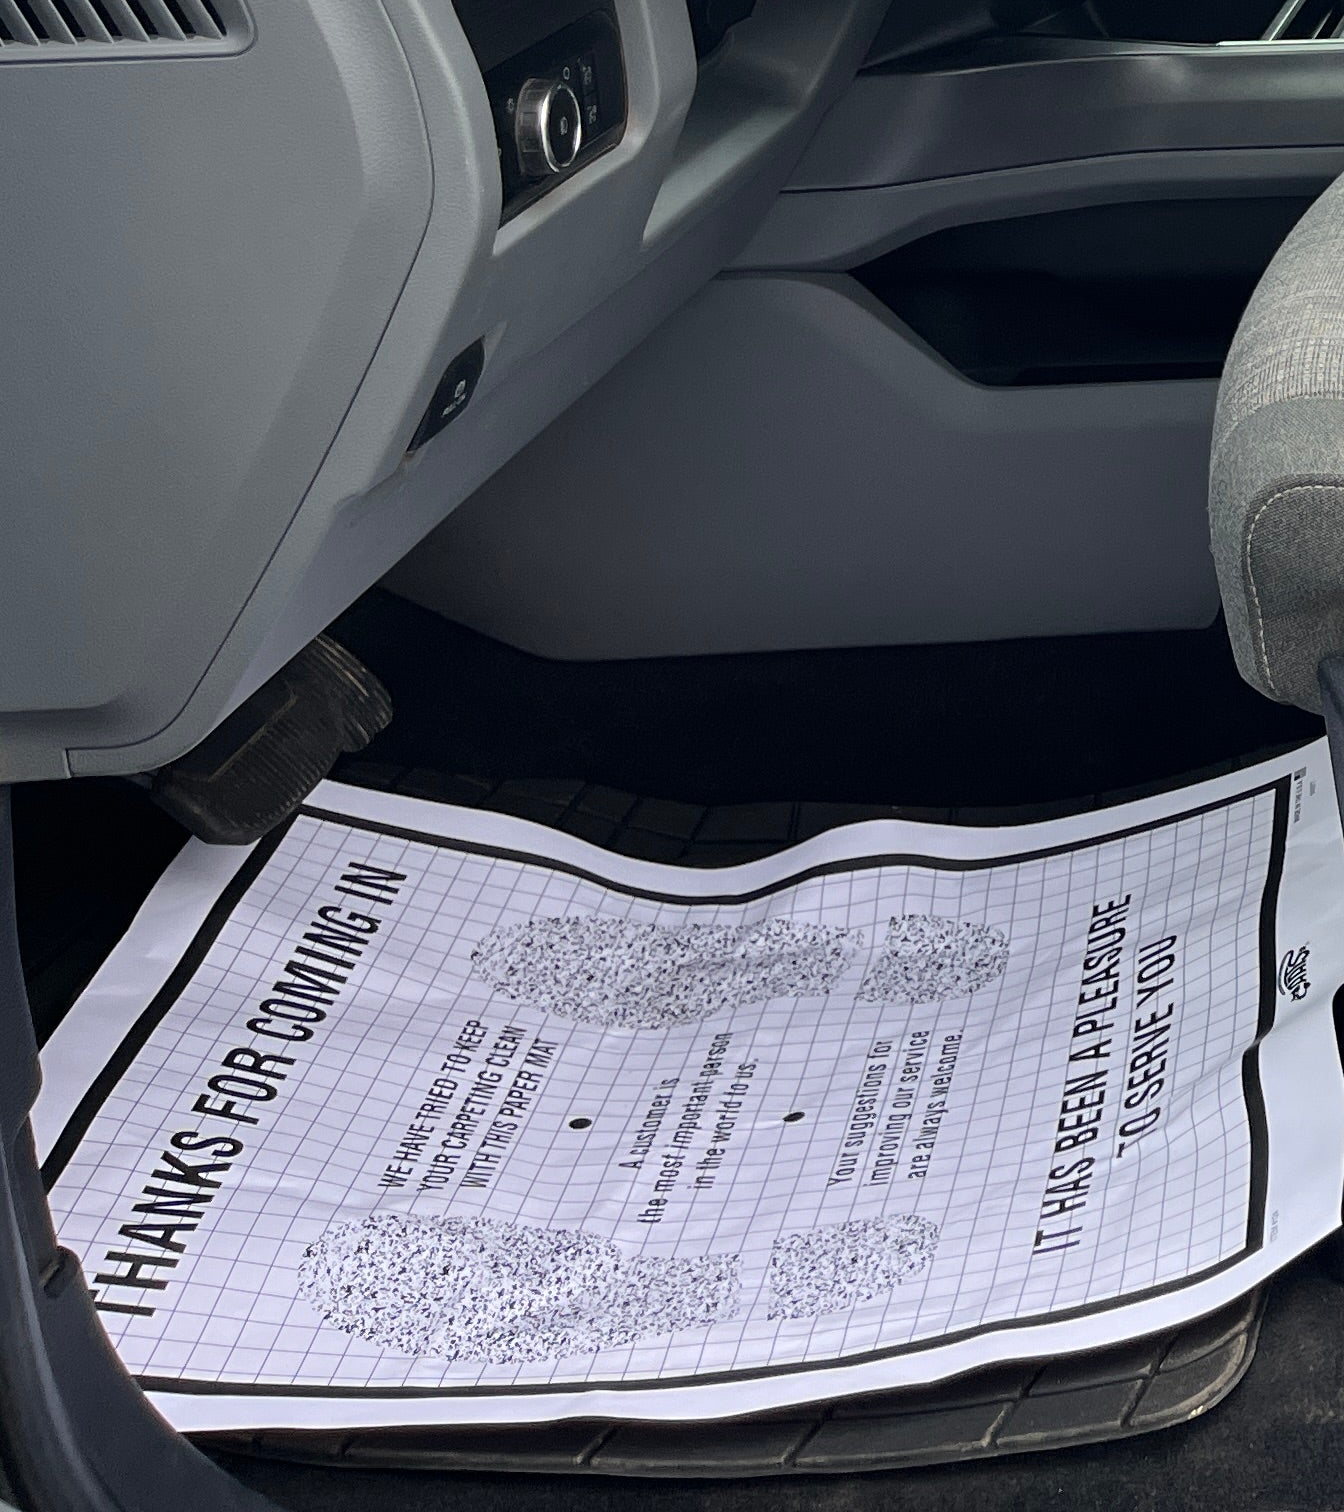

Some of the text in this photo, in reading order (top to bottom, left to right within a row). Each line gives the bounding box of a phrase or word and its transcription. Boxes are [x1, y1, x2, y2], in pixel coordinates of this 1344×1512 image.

[1136, 935, 1177, 1009] YOU
[91, 861, 407, 1318] THANKS FOR COMING IN
[377, 1019, 489, 1188] WE HAVE TRIED TO KEEP
[416, 1025, 527, 1192] YOUR CARPETING CLEAN
[459, 1038, 559, 1188] WITH THIS PAPER MAT
[618, 1077, 680, 1170] A customer is
[637, 1032, 734, 1224] the most important person
[687, 1058, 759, 1190] in the world to us.
[827, 1040, 893, 1187] Your suggestions for
[863, 1030, 930, 1186] improving our service
[908, 1029, 964, 1179] are always welcome.
[1032, 893, 1132, 1255] IT HAS BEEN A PLEASURE
[1124, 1002, 1174, 1110] SERVE
